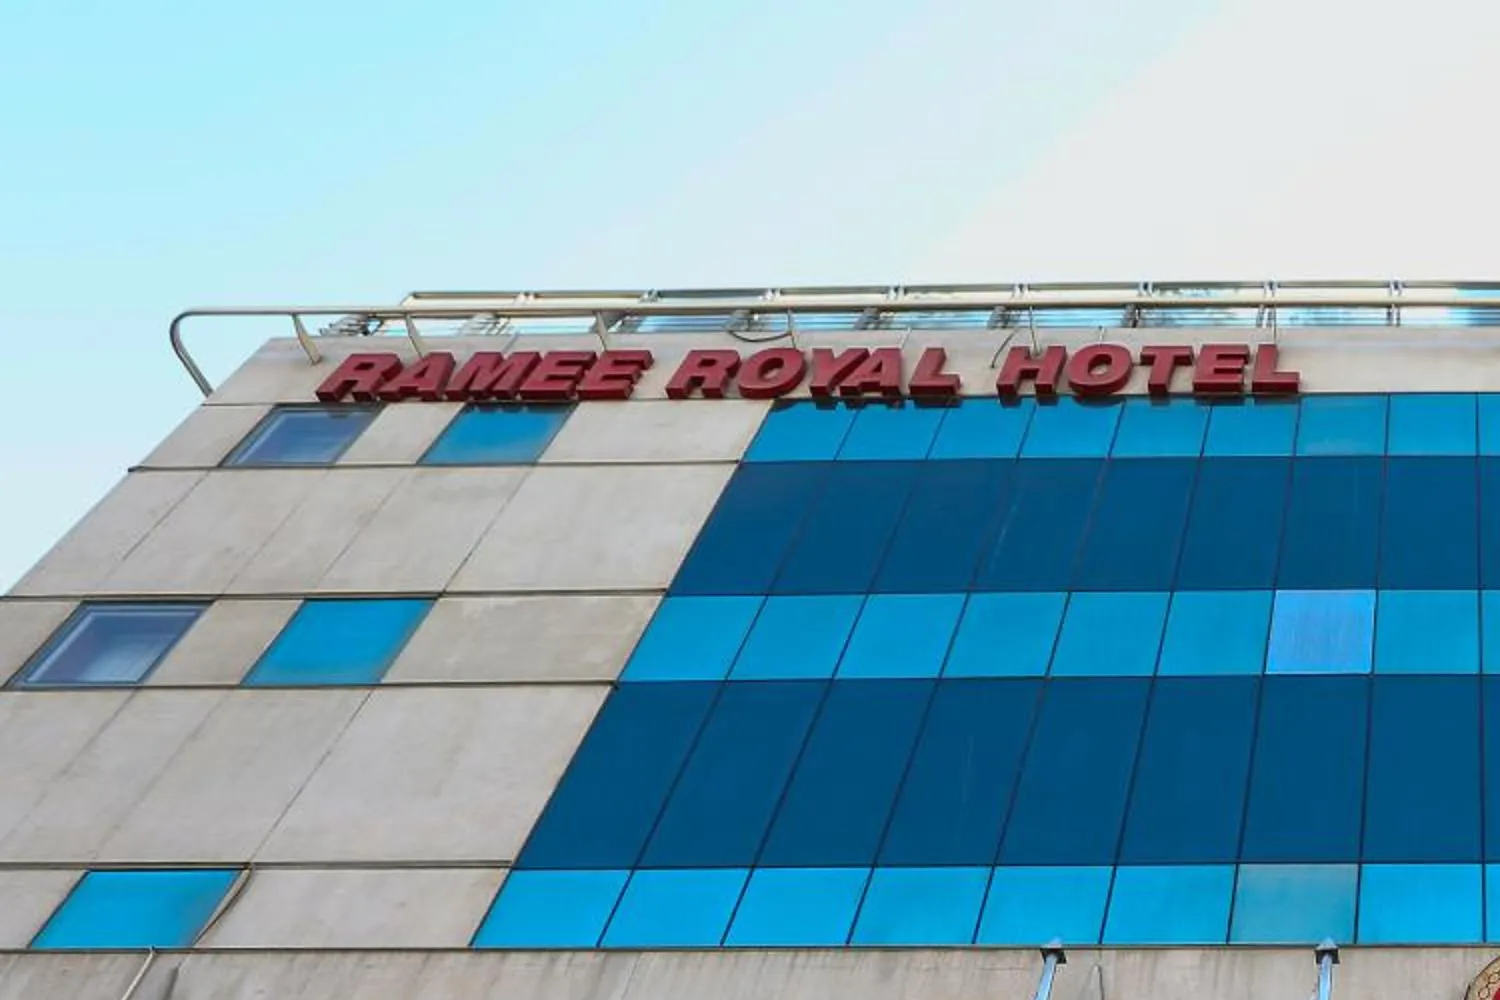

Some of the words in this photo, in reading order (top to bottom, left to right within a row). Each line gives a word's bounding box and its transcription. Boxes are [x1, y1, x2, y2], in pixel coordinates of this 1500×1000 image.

[315, 349, 654, 401] RAMEE
[665, 346, 961, 401] ROYAL
[996, 343, 1300, 395] HOTEL
